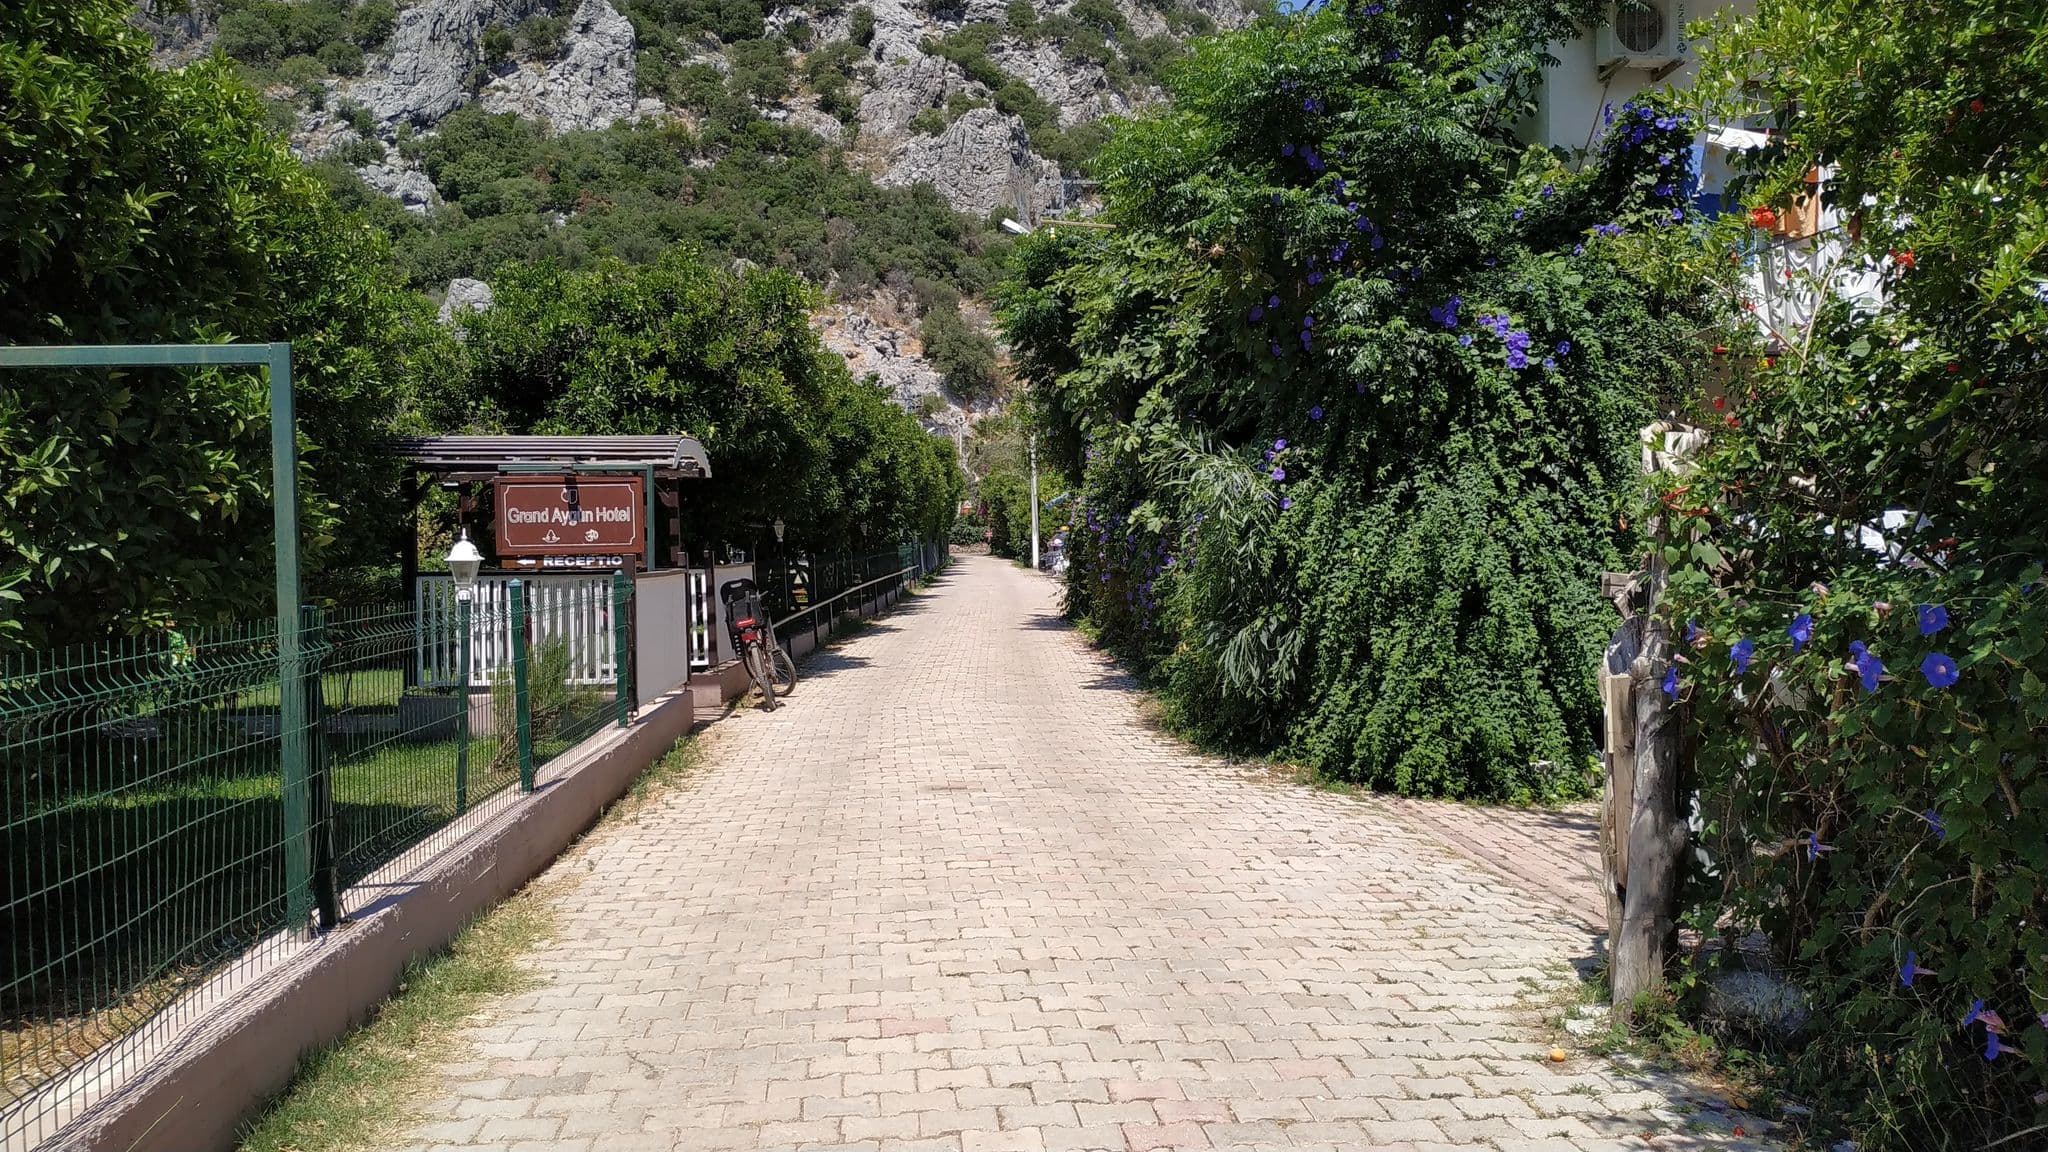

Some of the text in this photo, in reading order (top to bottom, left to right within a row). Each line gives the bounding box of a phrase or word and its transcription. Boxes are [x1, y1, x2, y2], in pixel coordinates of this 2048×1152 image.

[508, 507, 548, 524] Grand
[596, 507, 631, 523] Hotel
[543, 556, 623, 567] RECEPTIO
